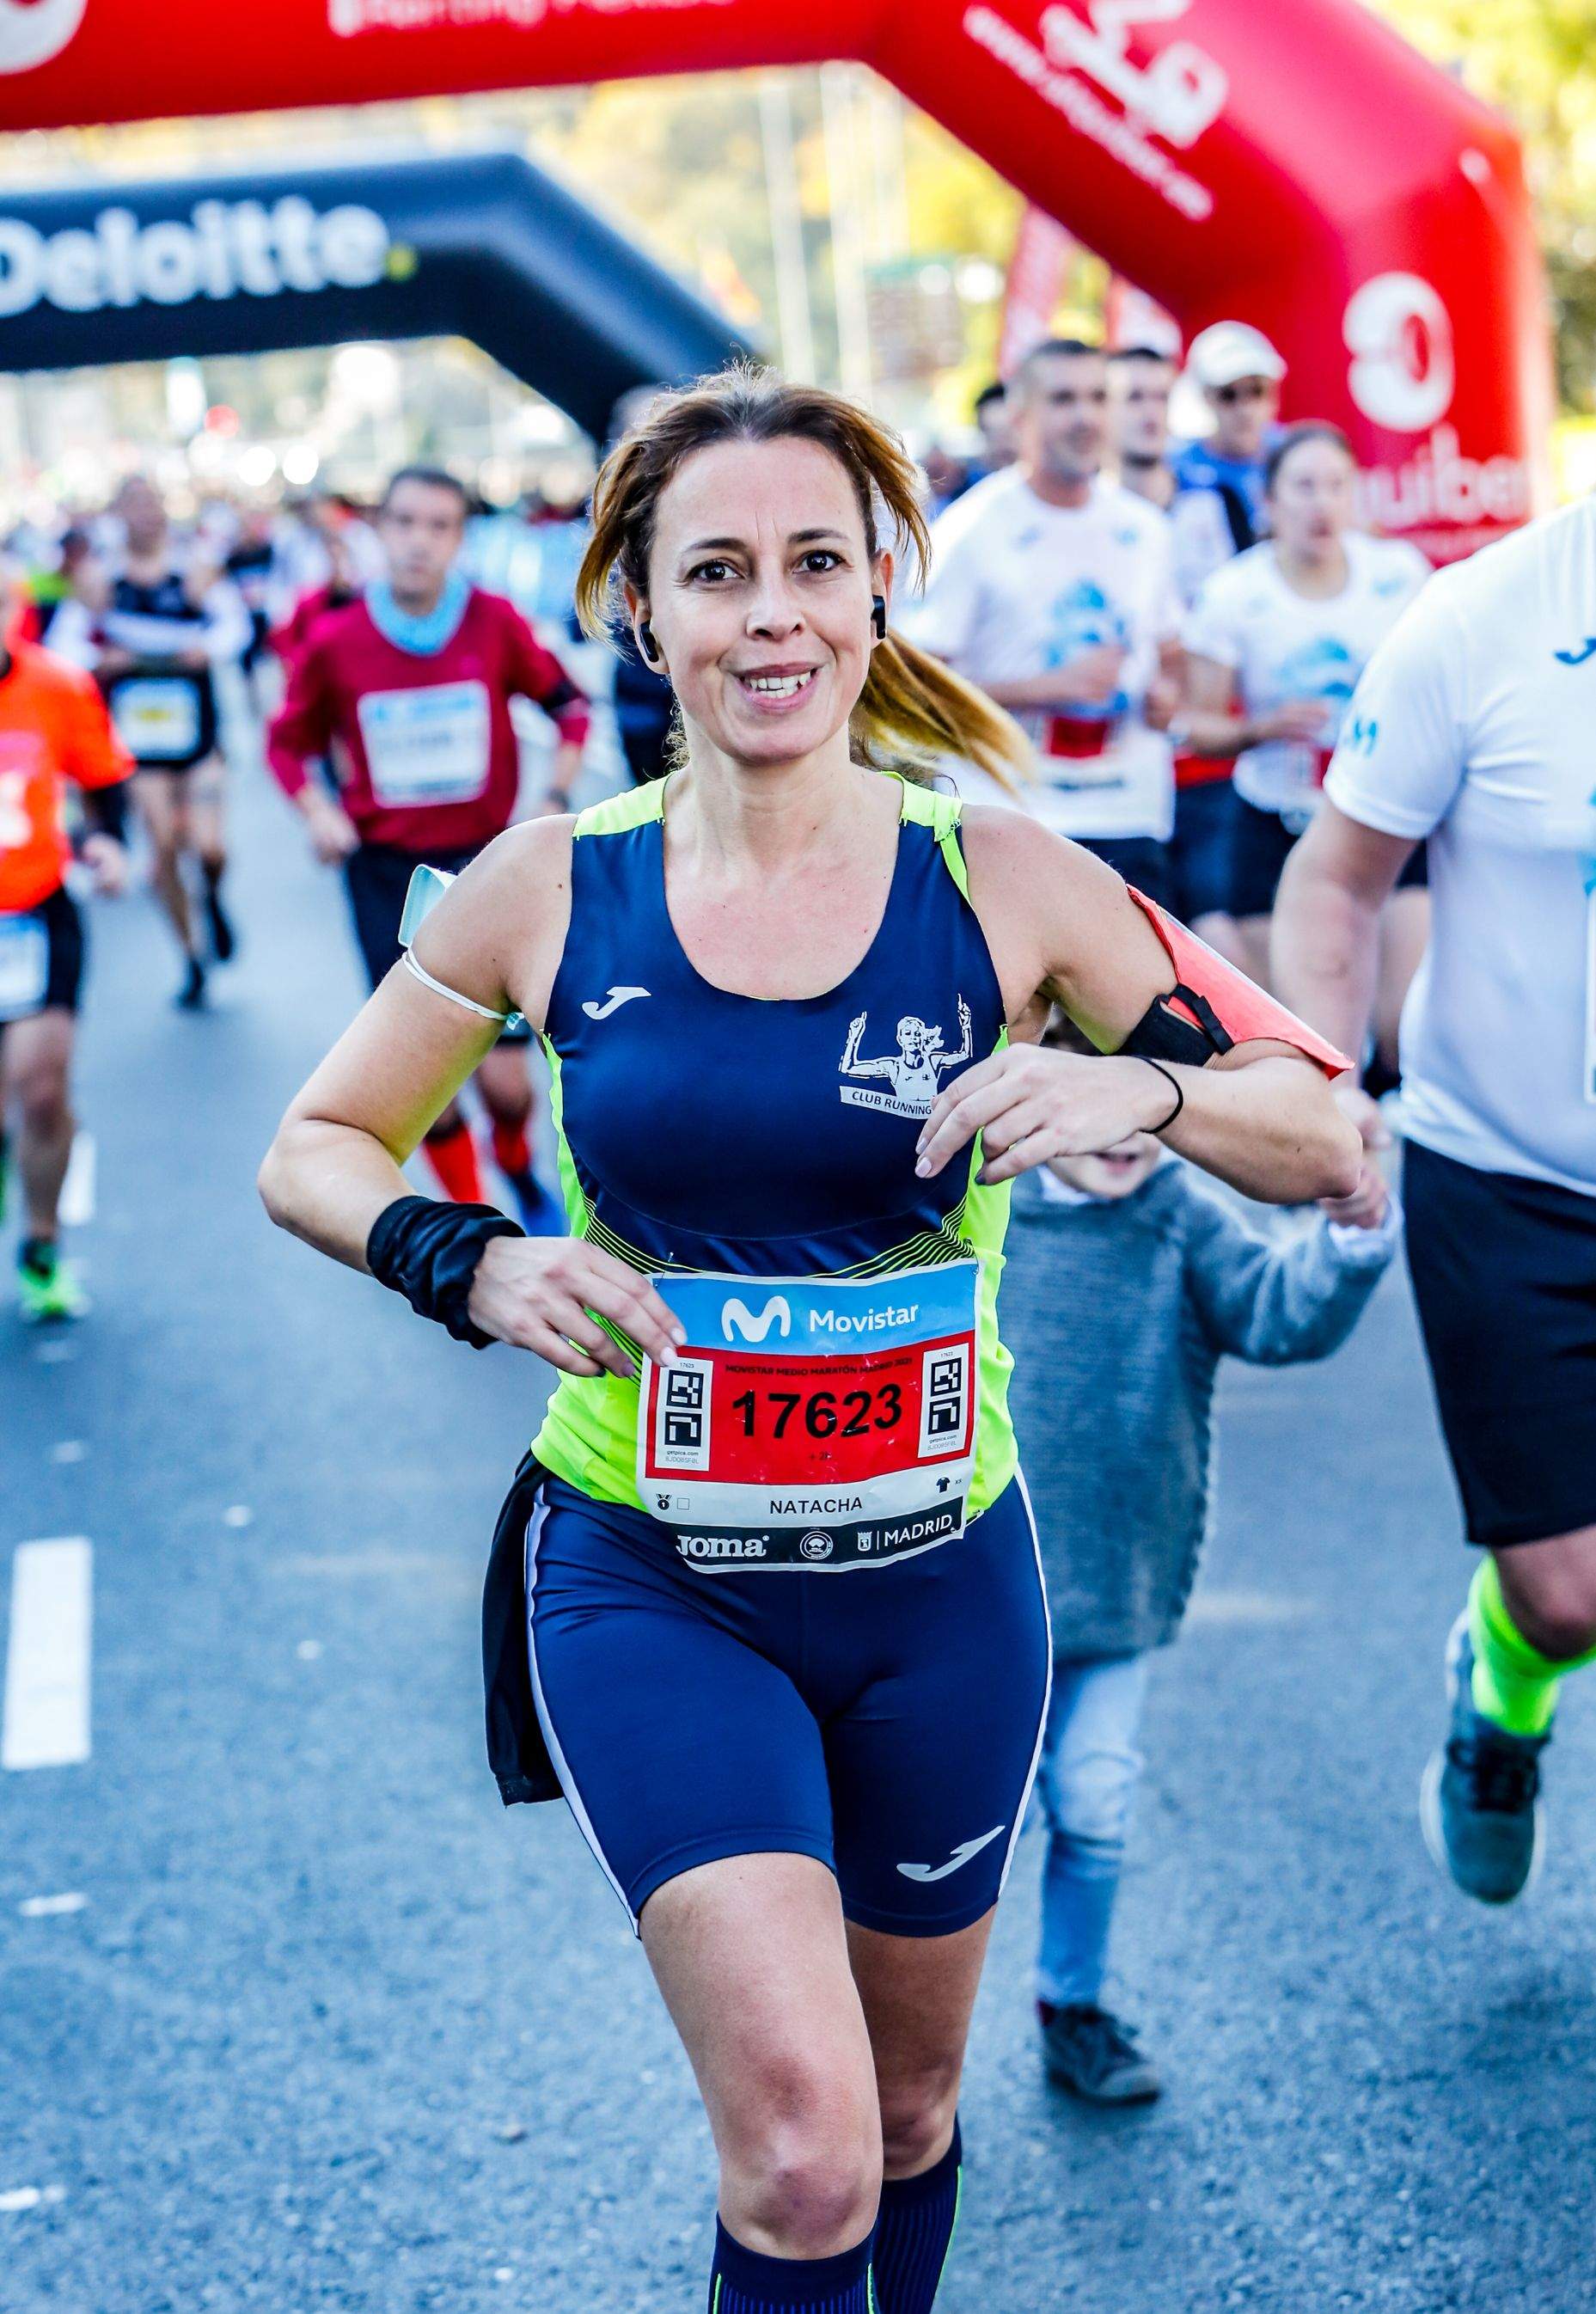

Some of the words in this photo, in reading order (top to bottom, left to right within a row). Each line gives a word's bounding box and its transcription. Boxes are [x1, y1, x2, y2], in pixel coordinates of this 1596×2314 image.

[852, 1091, 882, 1105] CLUB
[884, 1098, 933, 1115] RUNNING
[810, 1304, 919, 1332] Movistar
[725, 1363, 774, 1375] MOVISTAR
[776, 1367, 809, 1376] MEDIO
[732, 1383, 902, 1439] 17623
[769, 1497, 863, 1514] NATACHA
[884, 1514, 953, 1546] MADRID
